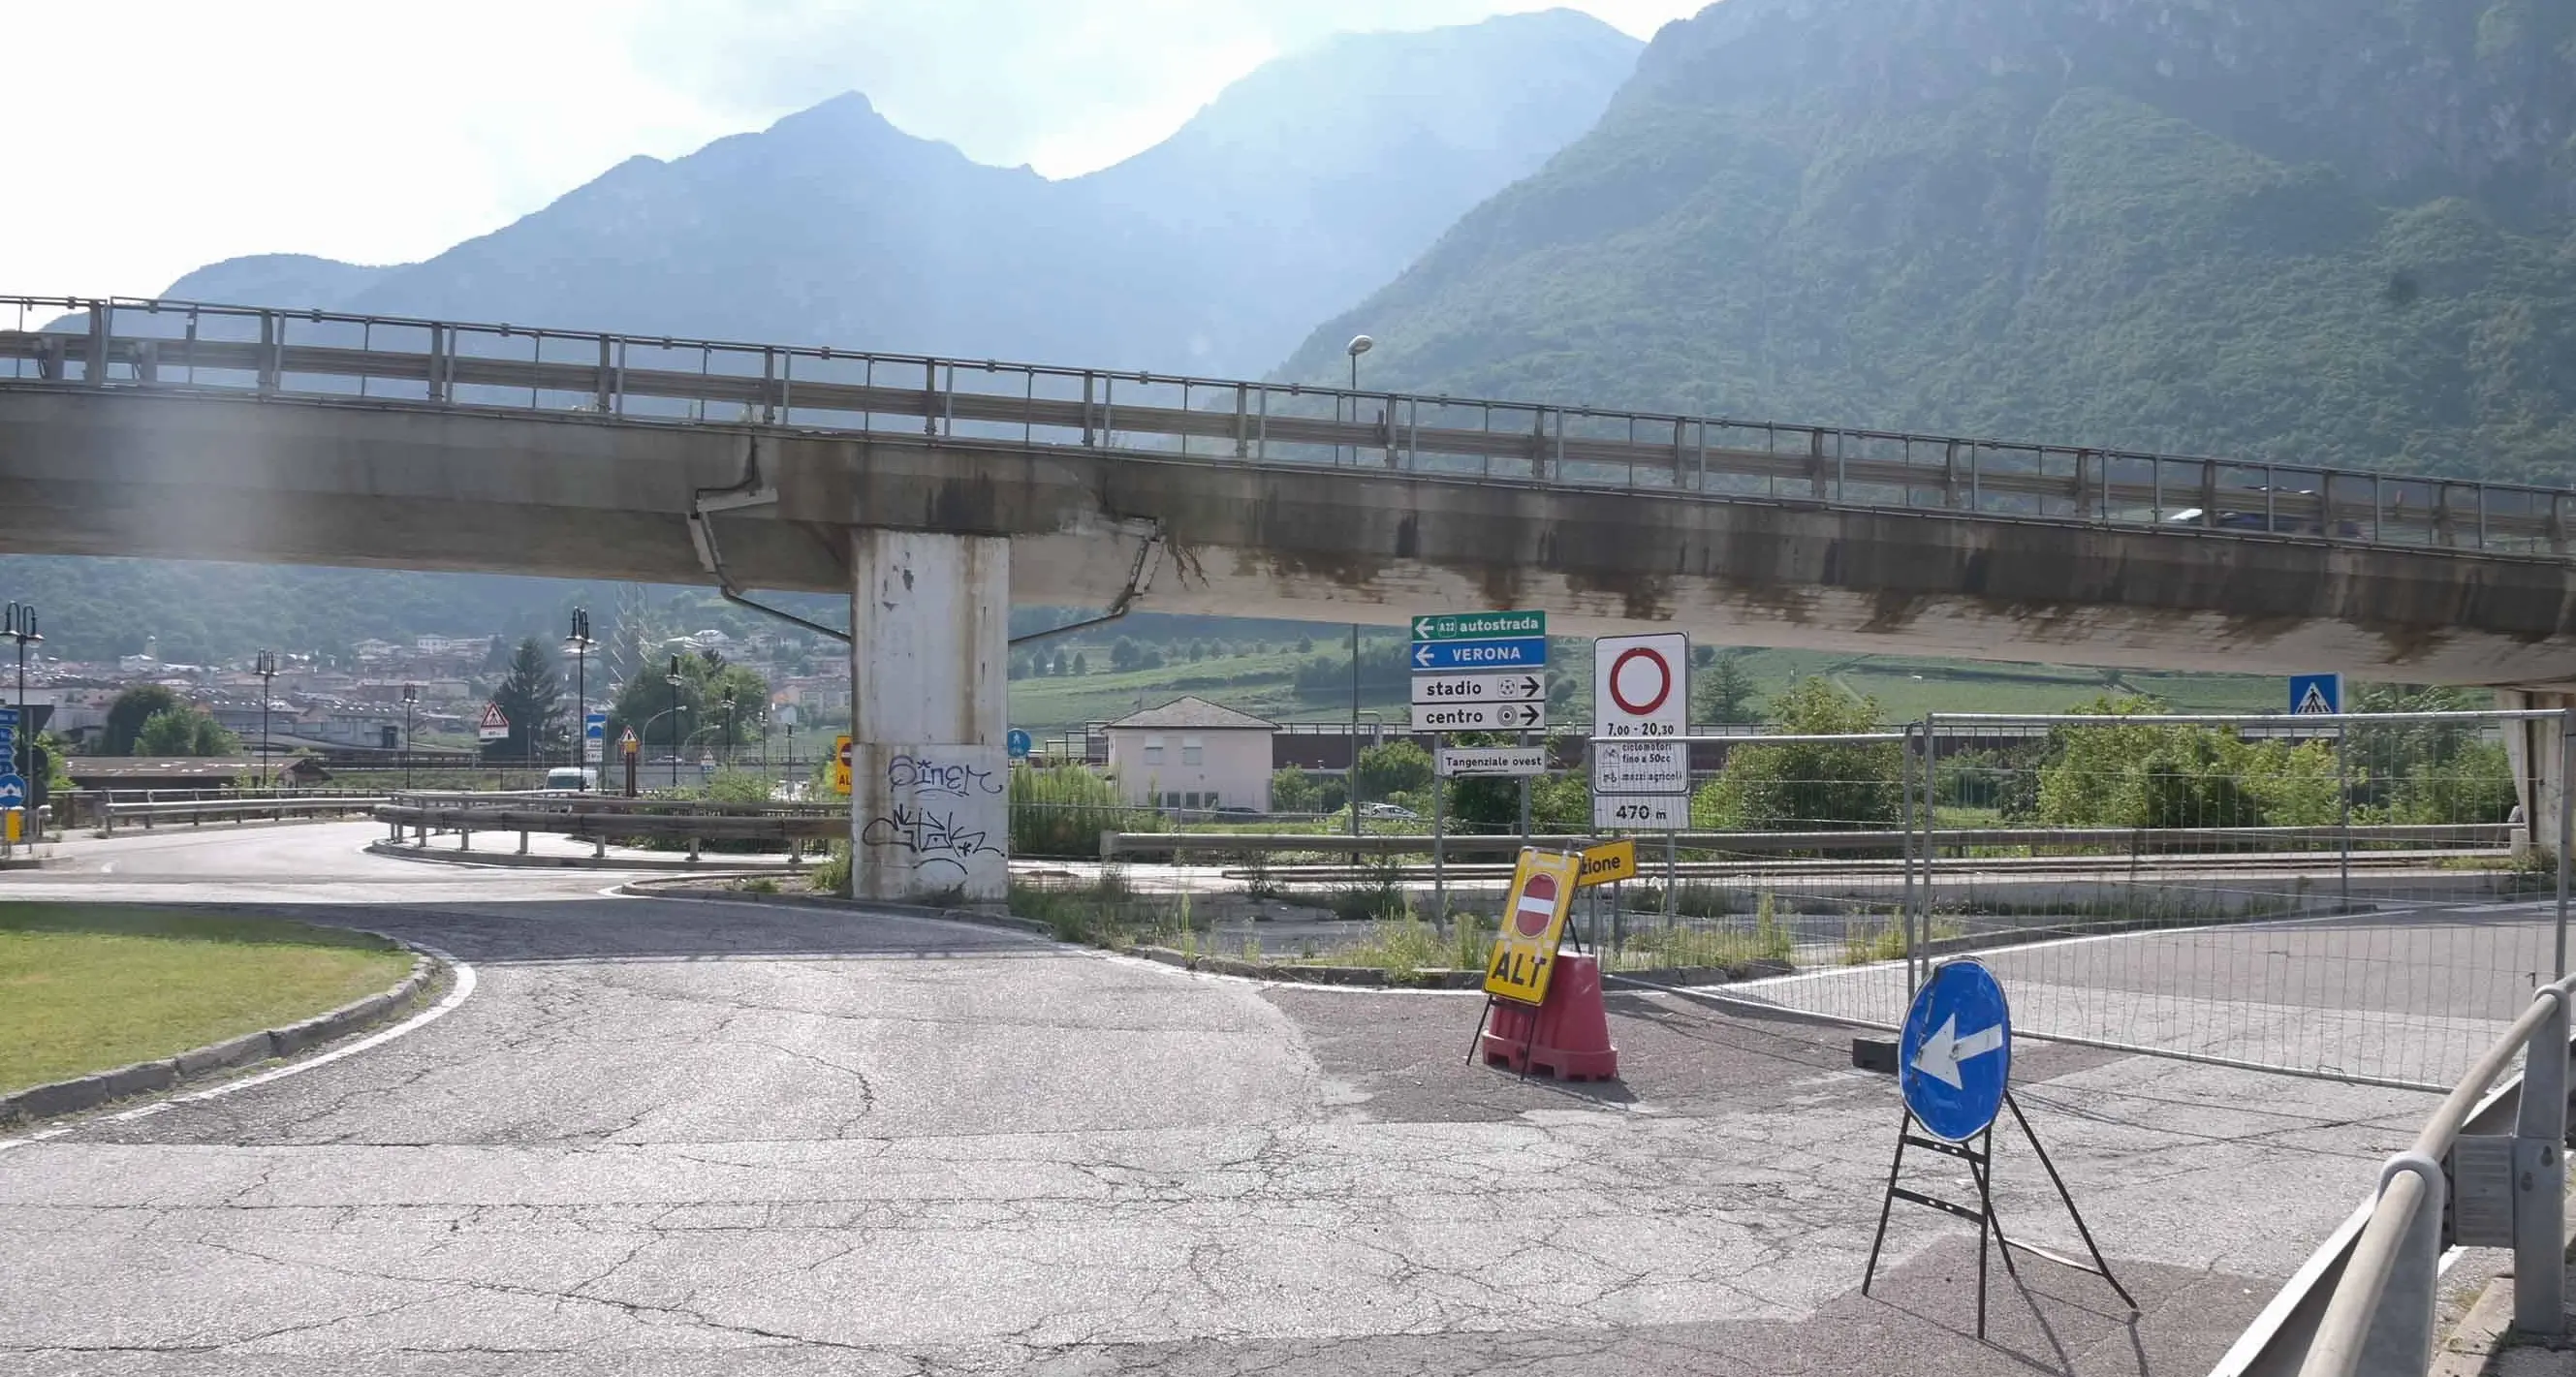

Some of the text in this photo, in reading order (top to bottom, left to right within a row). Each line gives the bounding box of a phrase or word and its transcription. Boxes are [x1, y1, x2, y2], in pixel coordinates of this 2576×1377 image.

[1460, 617, 1539, 633] autostrada
[1453, 646, 1522, 662] VERONA
[1427, 680, 1482, 696] stadio
[1427, 709, 1483, 724] centro
[1445, 756, 1542, 768] Tangenziale ovest
[1622, 753, 1640, 764] fino
[1649, 753, 1671, 763] 50cc
[838, 774, 853, 786] AL
[1616, 804, 1667, 820] 470 m
[1491, 951, 1547, 988] ALT
